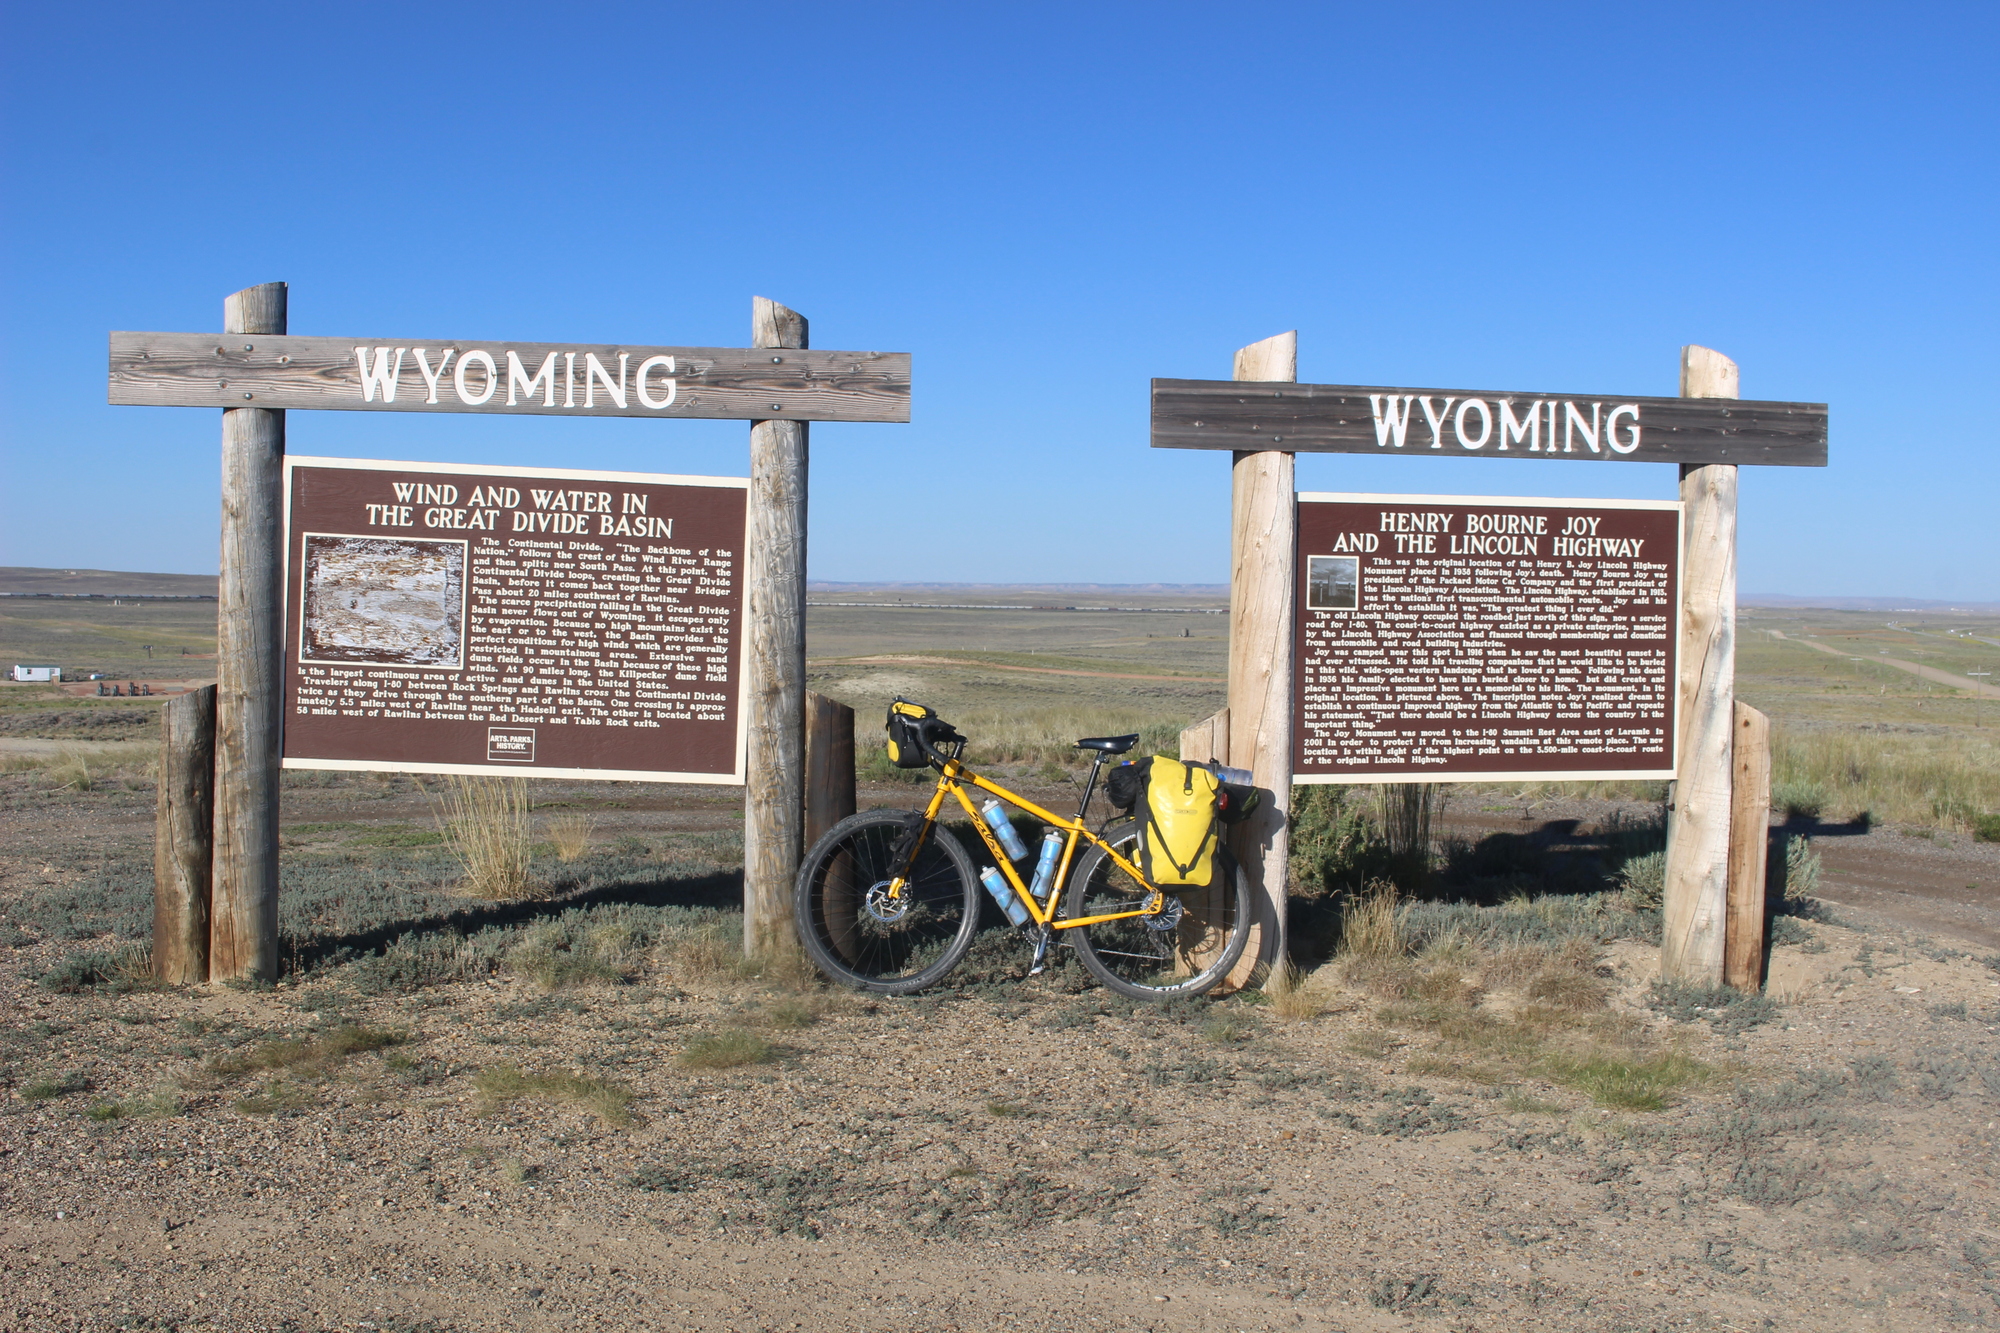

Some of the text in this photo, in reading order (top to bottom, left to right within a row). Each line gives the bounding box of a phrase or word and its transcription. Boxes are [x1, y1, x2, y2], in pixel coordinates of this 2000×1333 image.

[355, 347, 677, 410] WYOMING
[1369, 394, 1641, 454] WYOMING
[392, 482, 647, 515] WIND AND WATER IN
[365, 503, 673, 539] THE GREAT DIVIDE BASIN
[1380, 513, 1601, 535] HENRY BOURNE JOY
[481, 536, 500, 546] The
[508, 538, 562, 549] Continental
[647, 545, 691, 555] Backbone
[716, 549, 732, 557] the
[1332, 533, 1644, 557] AND THE LINCOLN HIGHWAY
[1433, 558, 1465, 567] original
[1468, 558, 1502, 566] location
[1536, 560, 1561, 568] Henry
[1577, 560, 1592, 569] Joy
[1597, 560, 1627, 569] Lincoln
[1633, 561, 1667, 570] Highway
[1363, 575, 1403, 584] president
[1519, 577, 1556, 586] Company
[1618, 579, 1654, 588] president
[472, 586, 492, 595] Pass
[496, 587, 523, 596] about
[543, 589, 569, 598] miles
[573, 591, 620, 600] southwest
[471, 604, 496, 614] Basin
[533, 607, 557, 616] flows
[654, 613, 663, 621] it
[668, 616, 703, 624] escapes
[707, 616, 729, 625] only
[478, 595, 497, 604] The
[533, 599, 596, 609] precipitation
[599, 601, 630, 612] falling
[632, 602, 641, 611] in
[645, 603, 661, 612] the
[666, 604, 692, 613] Great
[698, 605, 729, 615] Divide
[471, 614, 484, 624] by
[553, 618, 590, 628] Because
[610, 621, 631, 631] high
[637, 624, 685, 632] mountains
[690, 625, 713, 633] exist
[1425, 639, 1458, 648] building
[297, 666, 306, 674] is
[308, 667, 325, 675] the
[330, 667, 363, 678] largest
[367, 670, 419, 679] continuous
[448, 673, 459, 681] of
[465, 674, 495, 682] active
[502, 675, 523, 683] sand
[529, 676, 557, 685] dunes
[562, 677, 572, 685] in
[577, 678, 592, 686] the
[597, 678, 629, 688] United
[1304, 700, 1342, 710] establish
[1404, 701, 1441, 711] improved
[1445, 702, 1477, 711] highway
[1636, 702, 1664, 710] repeats
[311, 706, 337, 715] miles
[384, 709, 421, 718] Rawlins
[424, 710, 464, 720] between
[468, 712, 484, 720] the
[489, 713, 506, 722] Red
[511, 713, 543, 723] Desert
[549, 716, 567, 724] and
[573, 716, 601, 725] Table
[606, 717, 628, 726] Rock
[1313, 728, 1330, 737] The
[1334, 729, 1350, 738] Joy
[1336, 756, 1369, 765] original
[1374, 754, 1404, 763] Lincoln
